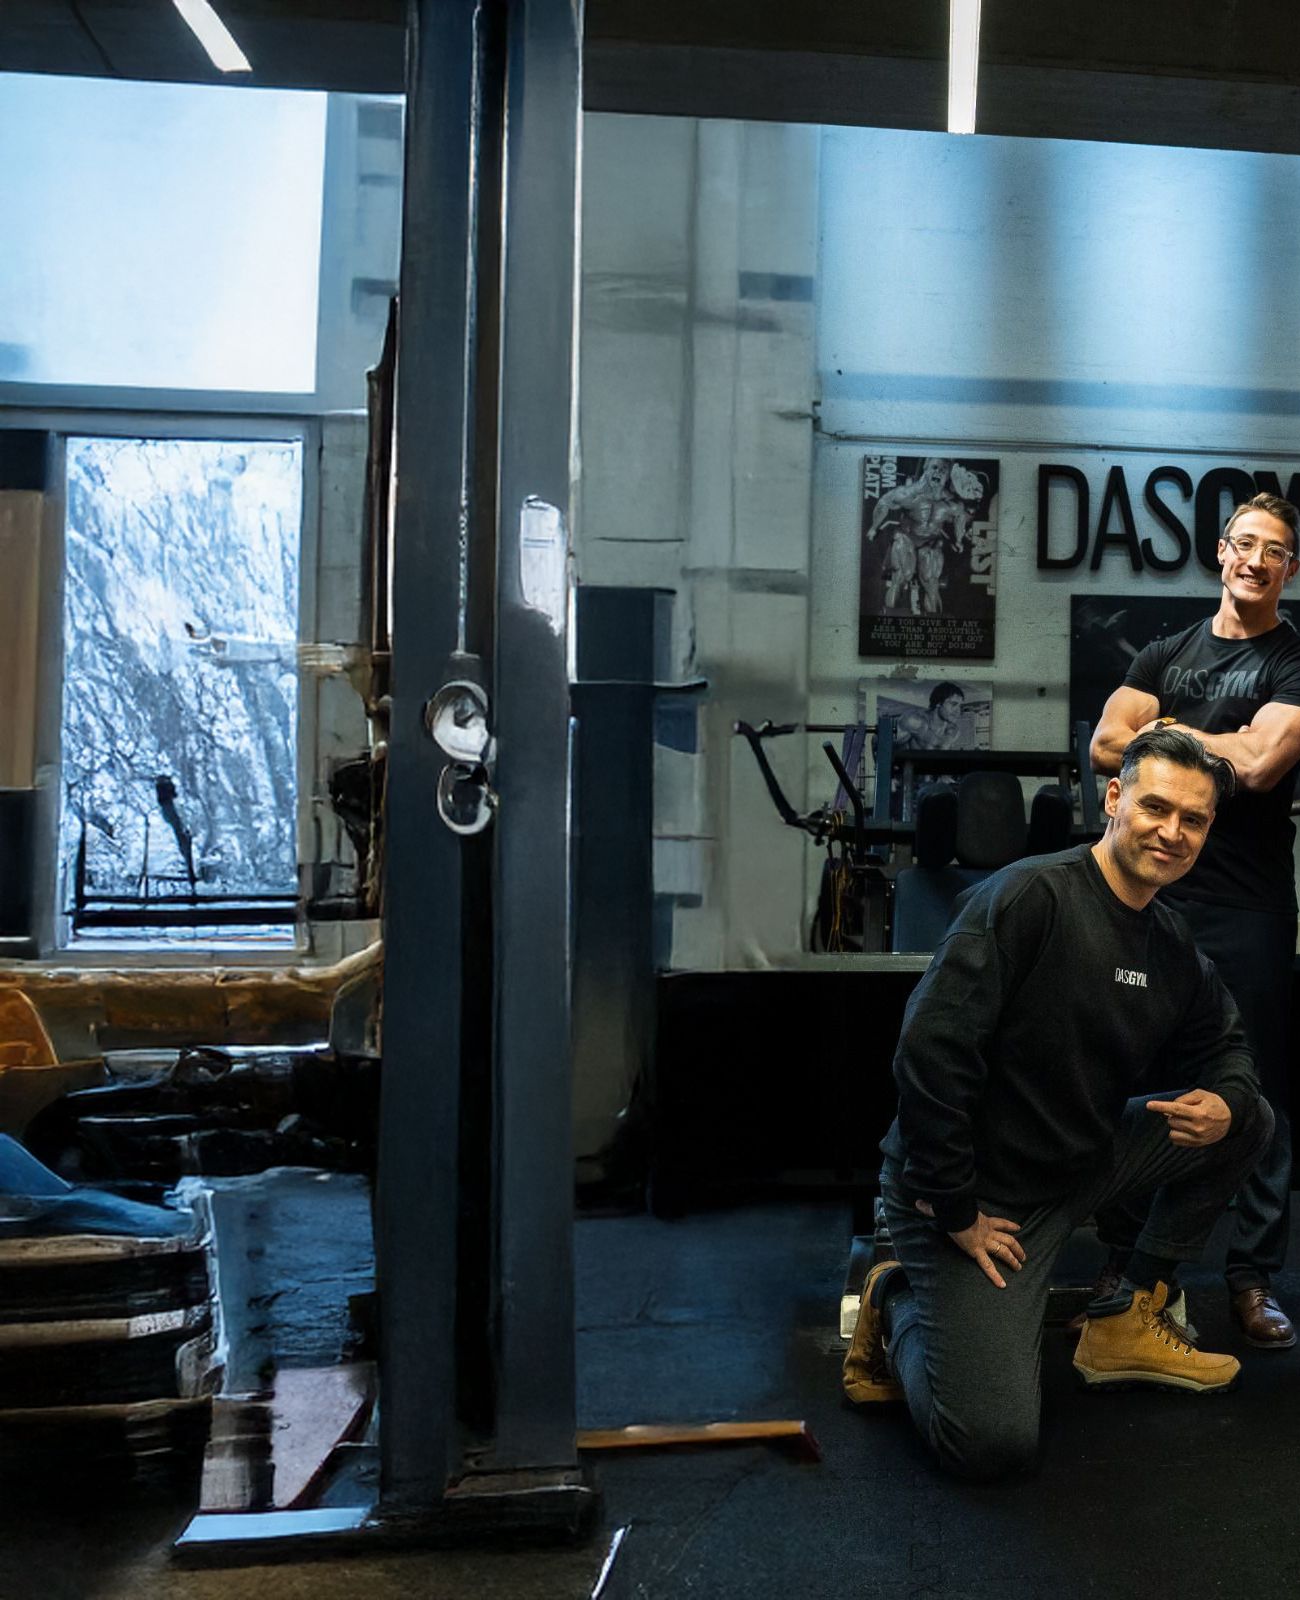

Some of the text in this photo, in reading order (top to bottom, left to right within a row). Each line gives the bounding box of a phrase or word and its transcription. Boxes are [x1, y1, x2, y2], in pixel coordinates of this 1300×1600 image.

[919, 618, 942, 626] GIVE
[947, 619, 957, 627] IT
[962, 620, 980, 628] ANY
[901, 625, 922, 633] THAN
[927, 626, 982, 635] ABSOLUTELY
[870, 632, 925, 641] EVERYTHING
[930, 634, 962, 642] YOU'VE
[927, 641, 943, 649] NOT
